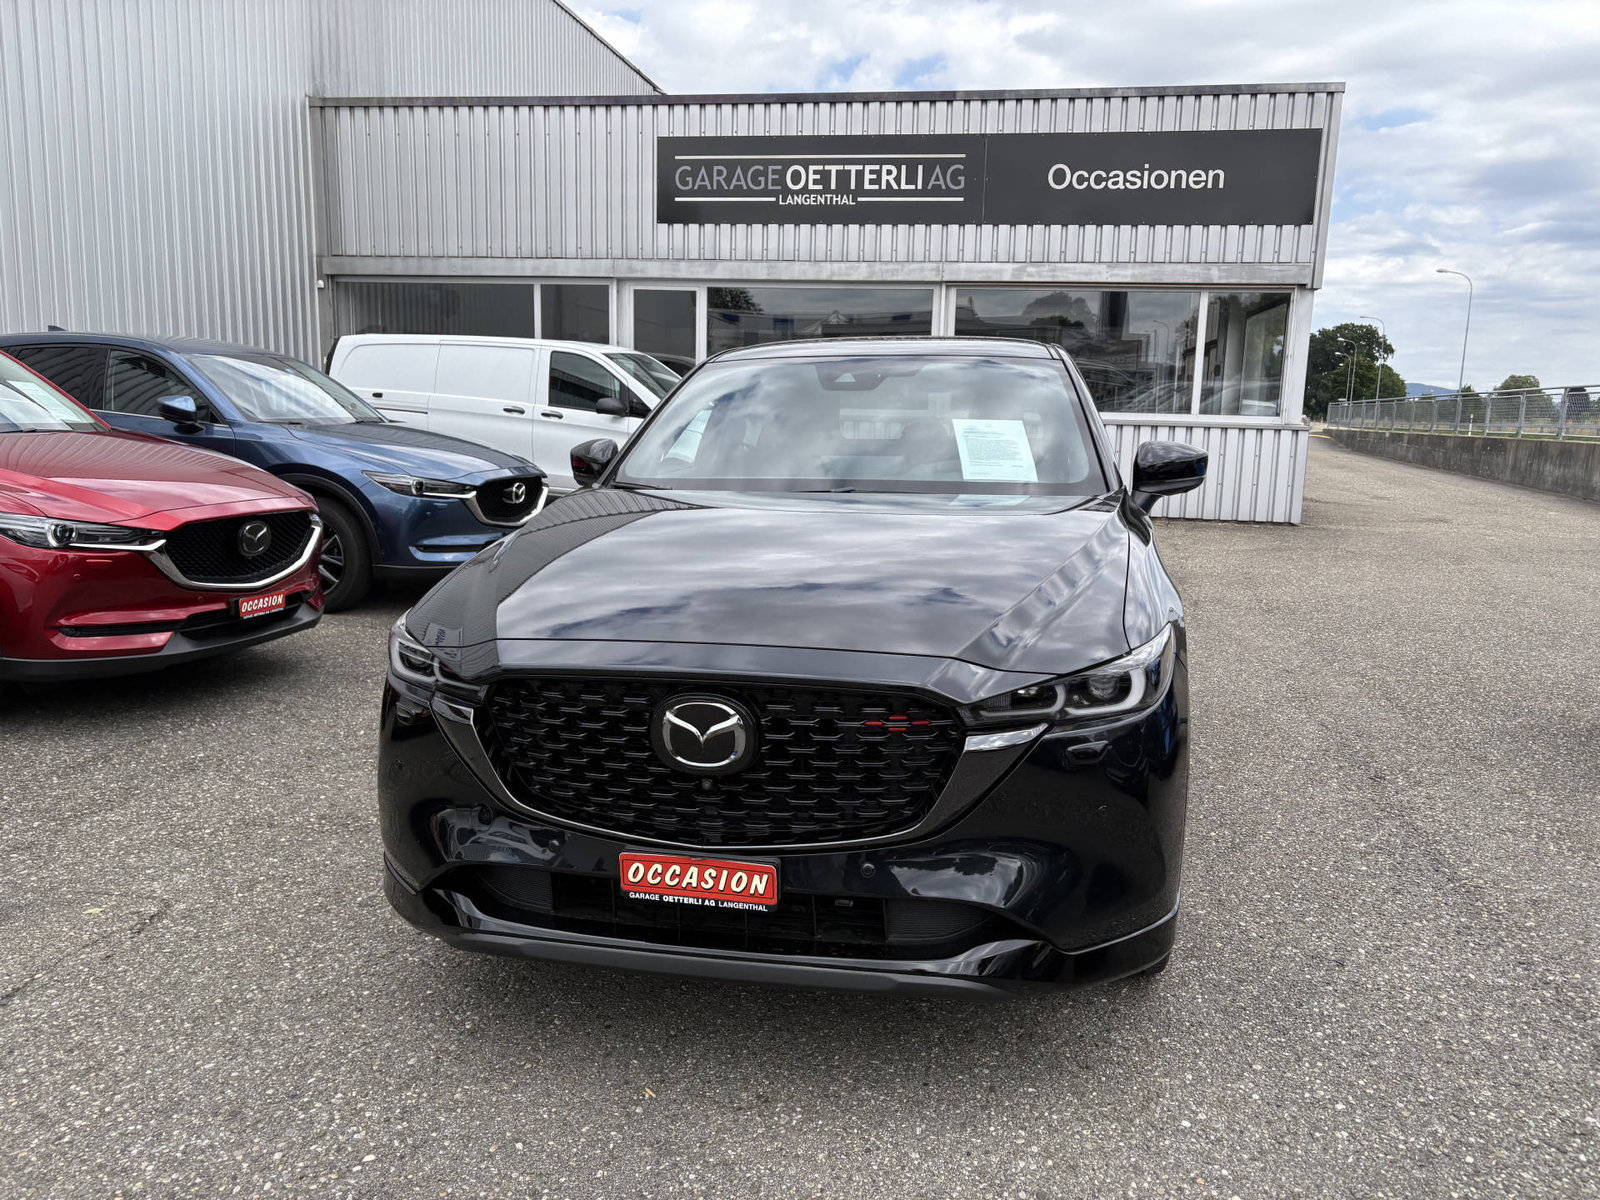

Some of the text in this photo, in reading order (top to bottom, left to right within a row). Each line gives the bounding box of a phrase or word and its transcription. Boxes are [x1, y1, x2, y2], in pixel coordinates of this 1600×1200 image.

[675, 164, 965, 190] GARAGE OETTERLI AG
[1048, 163, 1225, 190] Occasionen
[778, 194, 856, 206] LANGENTHAL
[242, 594, 283, 612] OCCASION
[627, 862, 769, 896] OCCASION
[629, 891, 768, 912] GARAGE OETTERLI AG LANGENTHAL
